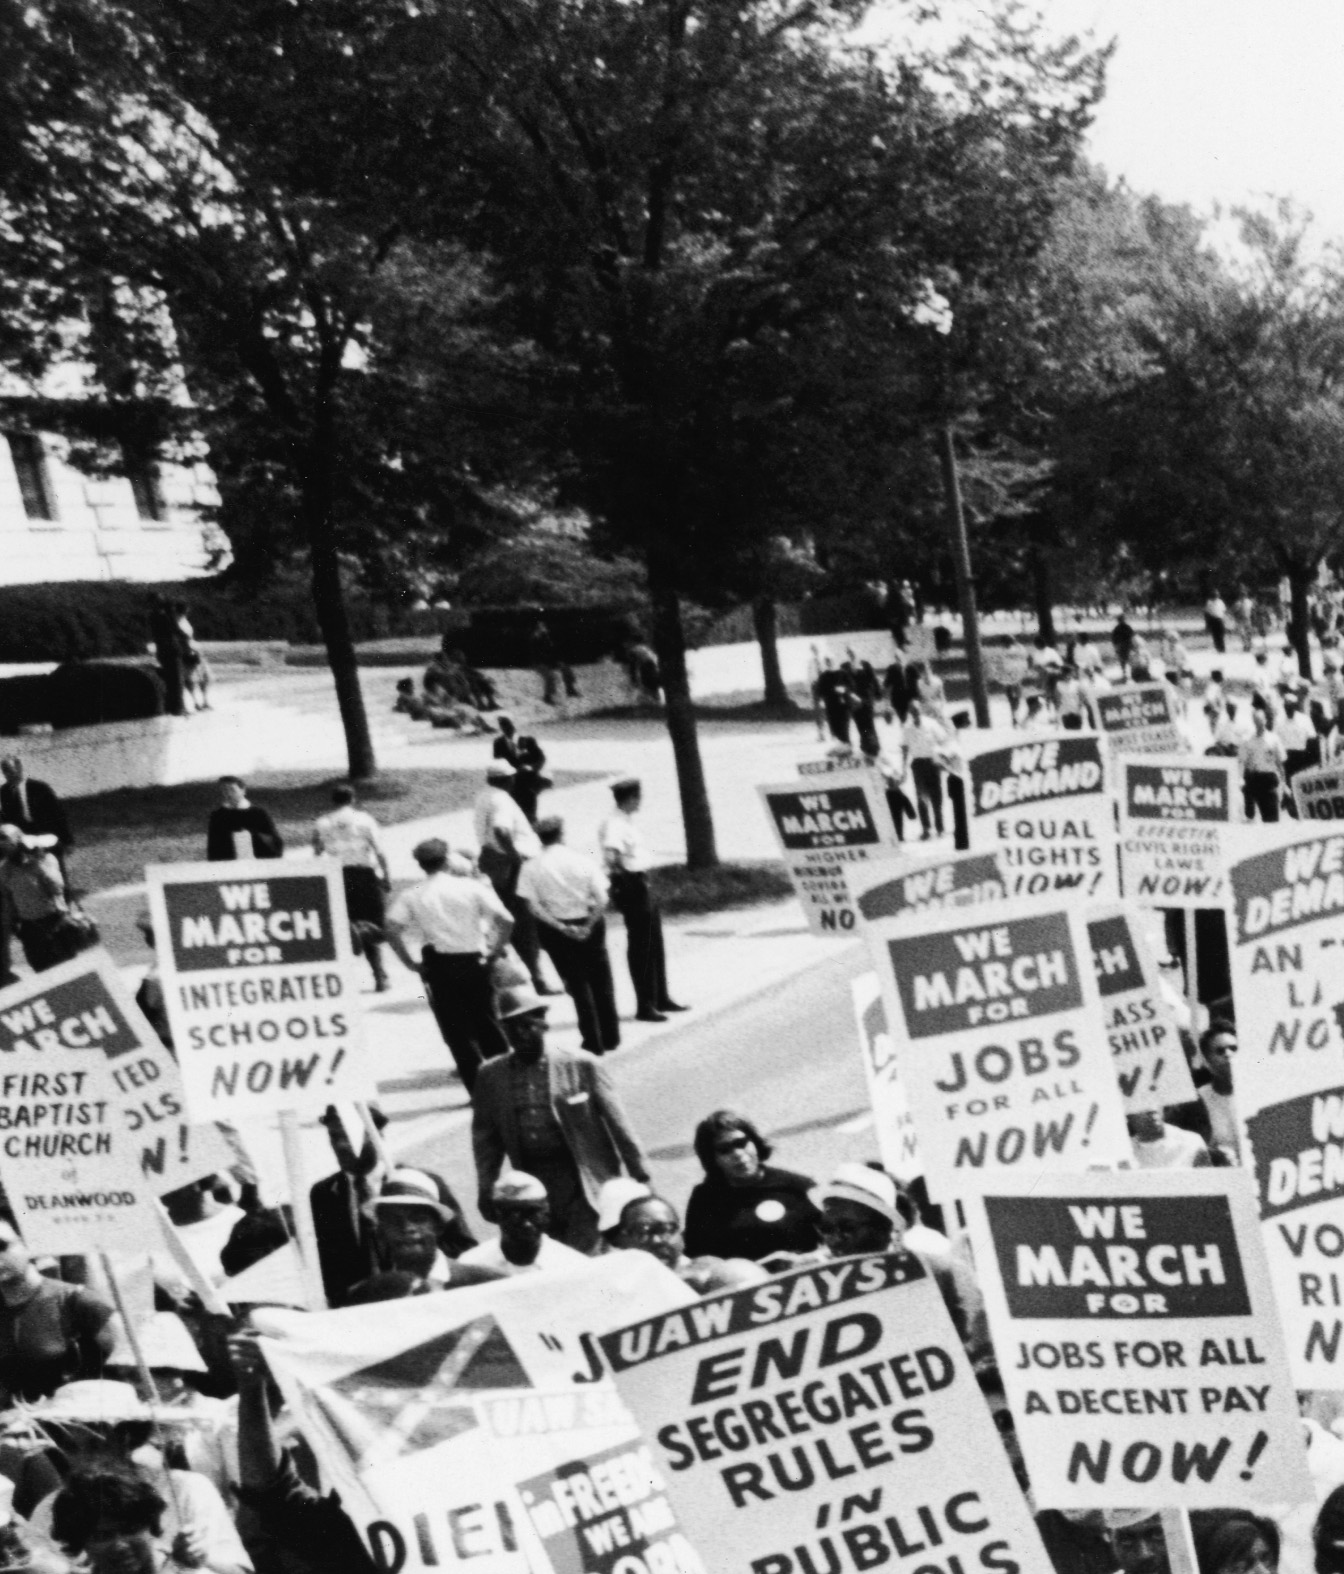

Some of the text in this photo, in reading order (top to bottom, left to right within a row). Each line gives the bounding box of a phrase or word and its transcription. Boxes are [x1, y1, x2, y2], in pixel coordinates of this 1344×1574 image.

[1010, 740, 1060, 774] WE
[979, 761, 1100, 810] DEMAND
[1160, 768, 1193, 787] WE
[1302, 776, 1339, 795] UAW
[799, 793, 831, 811] WE
[1132, 784, 1223, 809] MARCH
[1160, 806, 1197, 820] FOR
[781, 809, 868, 835] MARCH
[997, 819, 1095, 840] EQUAL
[804, 849, 868, 863] HIGHER
[218, 883, 272, 911] WE
[1137, 874, 1223, 898] NOW!
[180, 909, 323, 949] MARCH
[953, 925, 1013, 963] WE
[227, 946, 284, 966] FOR
[1250, 945, 1304, 975] AN
[179, 972, 344, 1012] INTEGRATED
[912, 949, 1070, 1013] MARCH
[2, 998, 57, 1037] WE
[967, 998, 1030, 1026] FOR
[188, 1013, 349, 1050] SCHOOLS
[1107, 1024, 1168, 1056] SHIP
[210, 1046, 346, 1099] NOW!
[934, 1028, 1082, 1093] JOBS
[2, 1071, 88, 1098] FIRST
[944, 1079, 1085, 1121] FOR ALL
[0, 1101, 108, 1130] BAPTIST
[4, 1132, 113, 1158] CHURCH
[954, 1100, 1099, 1169] NOW!
[24, 1190, 137, 1211] DEANWOOD
[1067, 1204, 1148, 1240] WE
[1015, 1243, 1227, 1288] MARCH
[619, 1253, 908, 1363] UAW SAYS:
[1085, 1292, 1169, 1314] FOR
[690, 1311, 885, 1407] END
[1016, 1336, 1266, 1370] JOBS FOR ALL
[656, 1345, 956, 1472] SEGREGATED
[1024, 1384, 1271, 1416] A DECENT PAY
[720, 1408, 936, 1509] RULES
[1066, 1429, 1270, 1486] NOW!
[584, 1513, 629, 1556] WE
